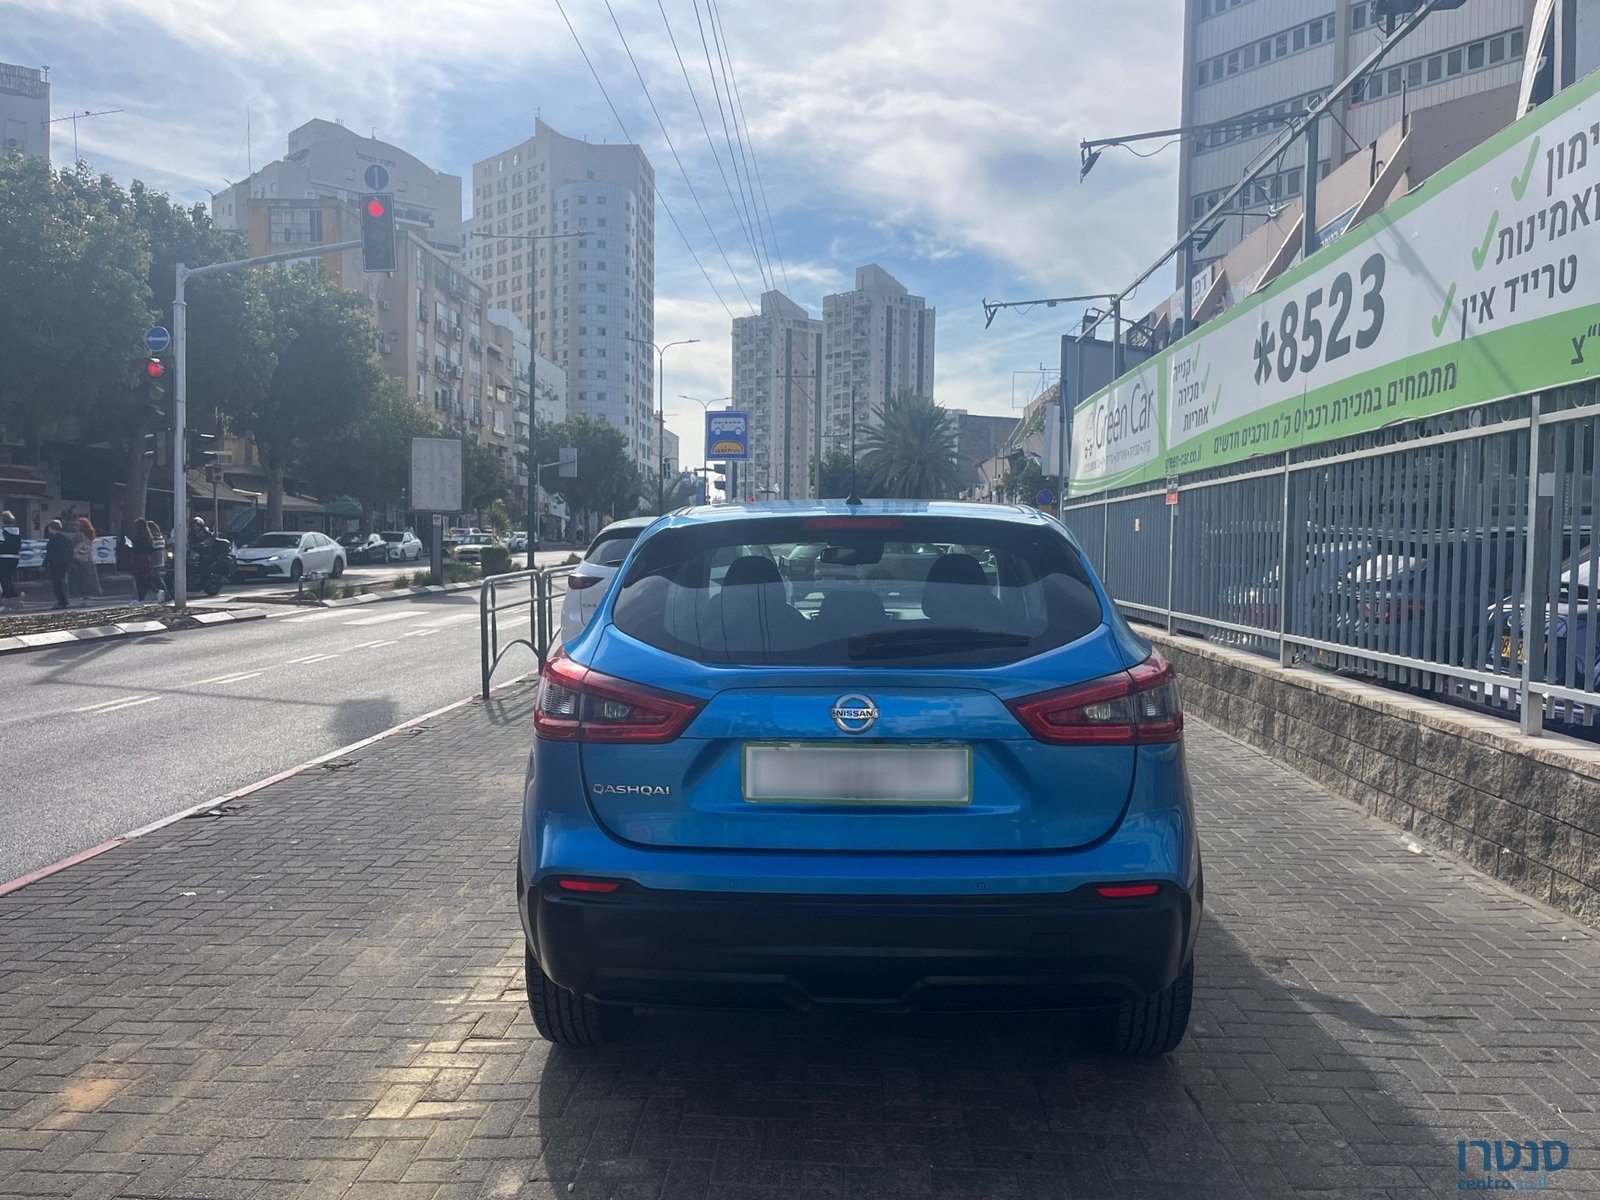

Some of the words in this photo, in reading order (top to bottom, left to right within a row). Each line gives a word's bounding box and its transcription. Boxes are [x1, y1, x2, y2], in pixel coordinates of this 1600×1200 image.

[1546, 122, 1600, 197] ימון
[1504, 254, 1577, 313] טרייד
[1460, 286, 1496, 340] אין
[1173, 358, 1192, 382] קנייה
[1178, 381, 1199, 407] מכירה
[1386, 362, 1457, 408] מתמחים
[1095, 403, 1128, 449] Green
[1130, 382, 1154, 435] Car
[1183, 405, 1209, 432] אחריות
[1304, 404, 1328, 431] רכבי
[1331, 386, 1382, 424] במכירת
[1213, 431, 1240, 454] חדשים
[1241, 421, 1270, 447] ורכבים
[836, 709, 873, 717] NISSAN
[592, 783, 671, 797] QASHQAI
